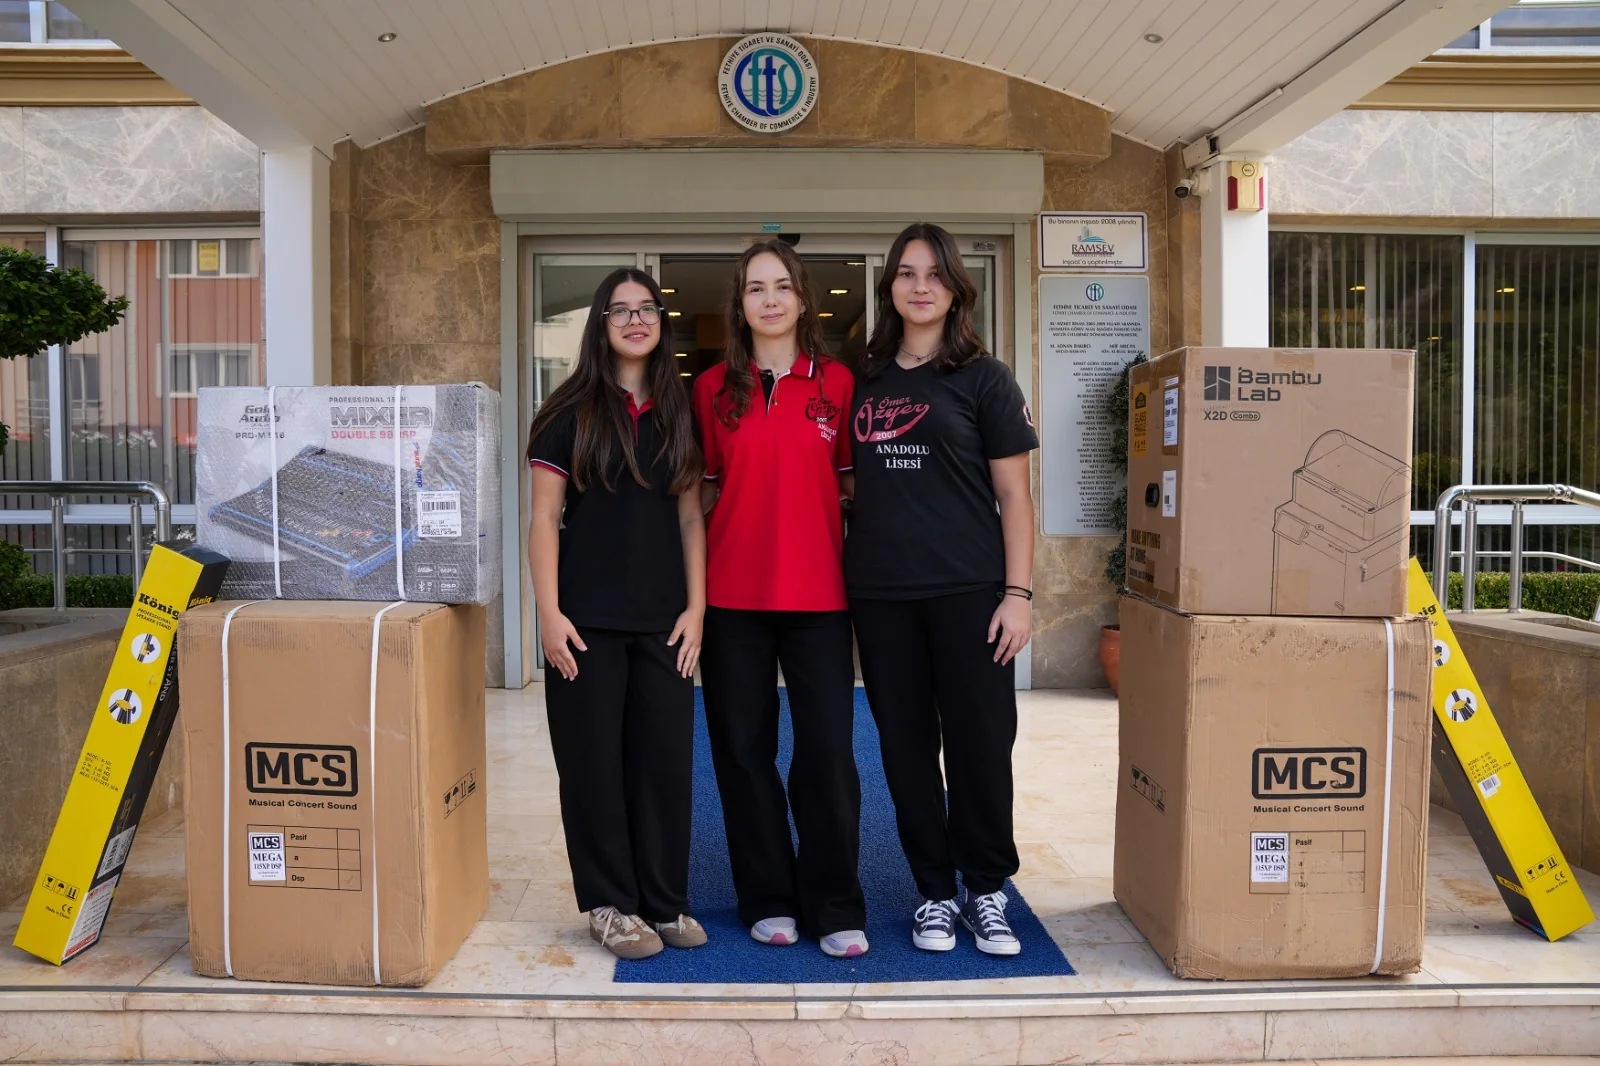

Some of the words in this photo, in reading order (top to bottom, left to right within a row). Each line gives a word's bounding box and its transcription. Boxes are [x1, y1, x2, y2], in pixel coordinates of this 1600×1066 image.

[738, 37, 764, 52] TİCARET
[776, 37, 799, 52] SANAYİ
[798, 50, 812, 70] ODASI
[731, 107, 758, 128] CHAMBER
[770, 111, 804, 130] COMMERCE
[804, 76, 816, 108] INDUSTRY
[1072, 244, 1114, 252] RAMSEV
[1238, 366, 1322, 384] Bambu
[1238, 386, 1280, 401] Lab
[879, 396, 912, 408] Ömer
[1204, 410, 1228, 420] X2D
[331, 430, 376, 439] DOUBLE
[876, 431, 896, 440] 2007
[876, 444, 930, 454] ANADOLU
[886, 457, 922, 468] LİSESİ
[138, 593, 180, 620] König
[136, 612, 156, 624] SPEAKER
[156, 620, 172, 630] STAND
[138, 608, 172, 625] PROFESSIONAL
[256, 752, 346, 787] MCS
[1264, 757, 1354, 790] MCS
[248, 799, 285, 807] Musical
[288, 800, 324, 809] Concert
[328, 802, 358, 810] Sound
[253, 837, 280, 849] MCS
[1256, 838, 1284, 850] MCS
[252, 853, 282, 862] MEGA
[1255, 854, 1286, 863] MEGA
